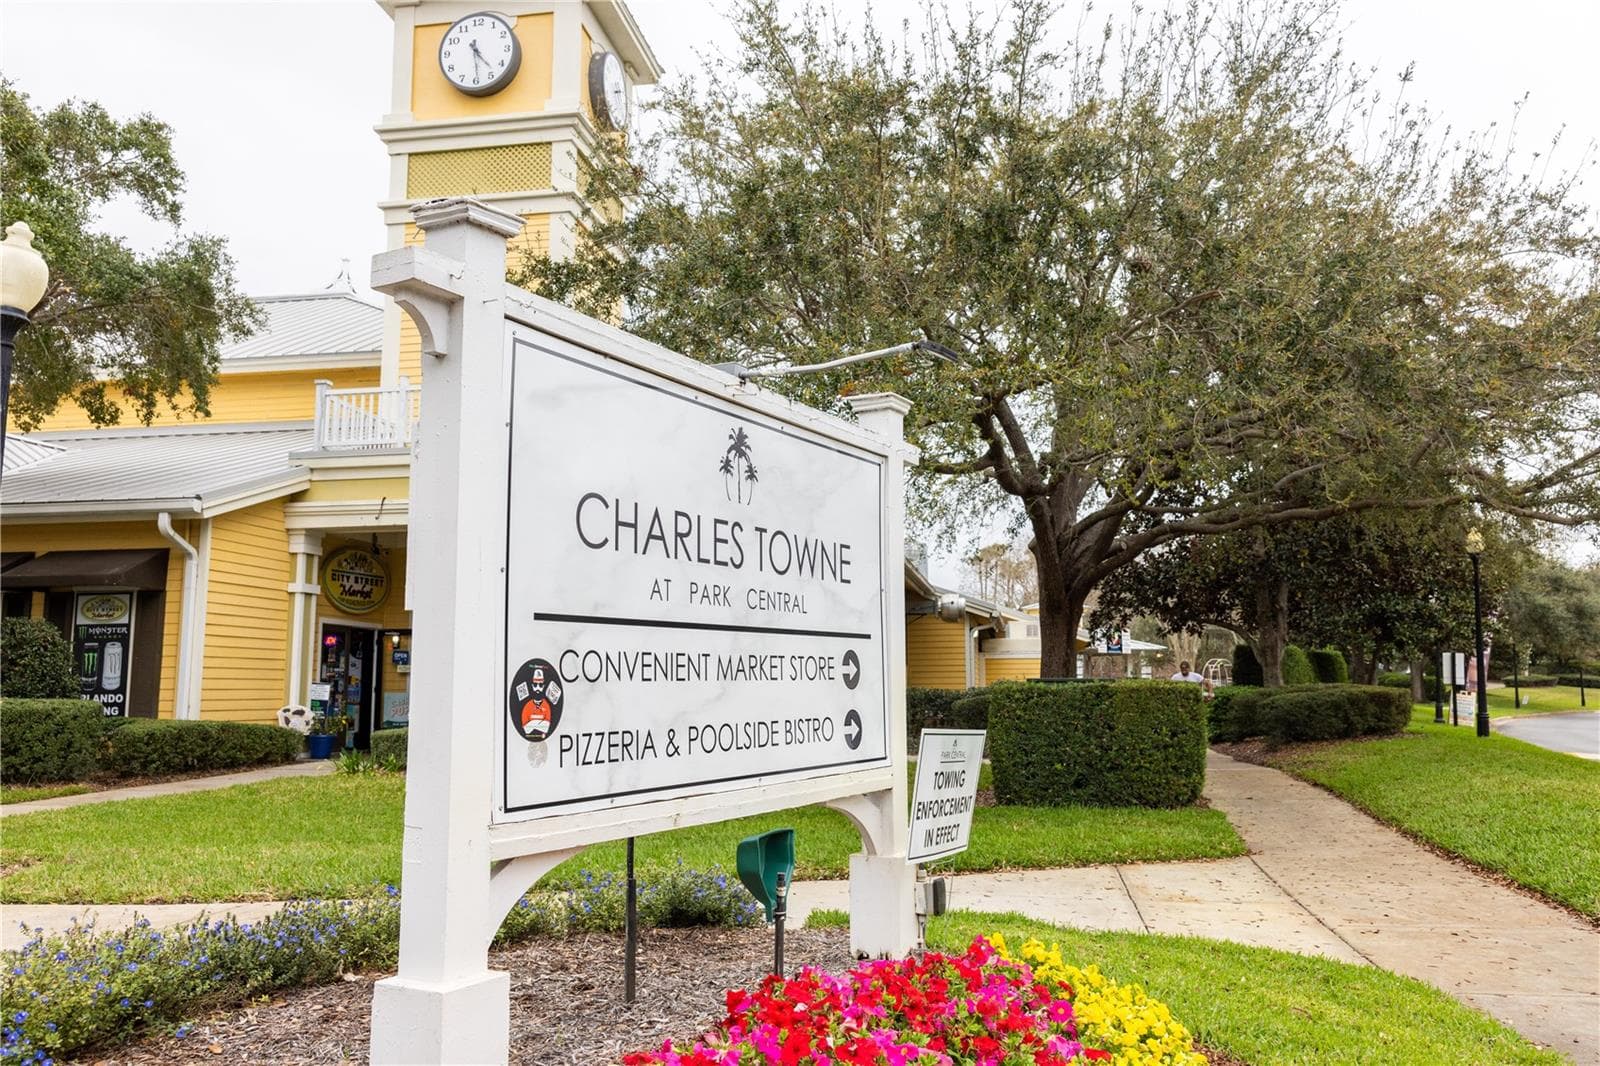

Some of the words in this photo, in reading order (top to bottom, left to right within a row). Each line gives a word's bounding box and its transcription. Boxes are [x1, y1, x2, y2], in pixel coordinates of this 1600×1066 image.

[473, 18, 484, 26] 12
[491, 21, 496, 29] 1
[459, 25, 468, 33] 11
[448, 37, 460, 45] 10
[498, 59, 504, 67] 4
[473, 76, 479, 85] 6
[488, 71, 494, 80] 5
[576, 492, 744, 569] CHARLES
[755, 526, 851, 585] TOWNE
[331, 573, 351, 583] CITY
[354, 576, 385, 587] STREET
[650, 578, 672, 602] AT
[689, 582, 731, 607] PARK
[746, 588, 808, 614] CENTRAL
[88, 626, 128, 635] MONSTER
[560, 649, 710, 683] CONVENIENT
[716, 654, 785, 682] MARKET
[790, 656, 835, 681] STORE
[560, 729, 657, 768] PIZZERIA
[666, 729, 680, 758] &
[689, 720, 779, 755] POOLSIDE
[785, 716, 834, 746] BISTRO
[933, 769, 966, 790] TOWING
[915, 795, 972, 821] ENFORCEMENT
[924, 828, 934, 848] IN
[935, 823, 960, 845] EFFECT
